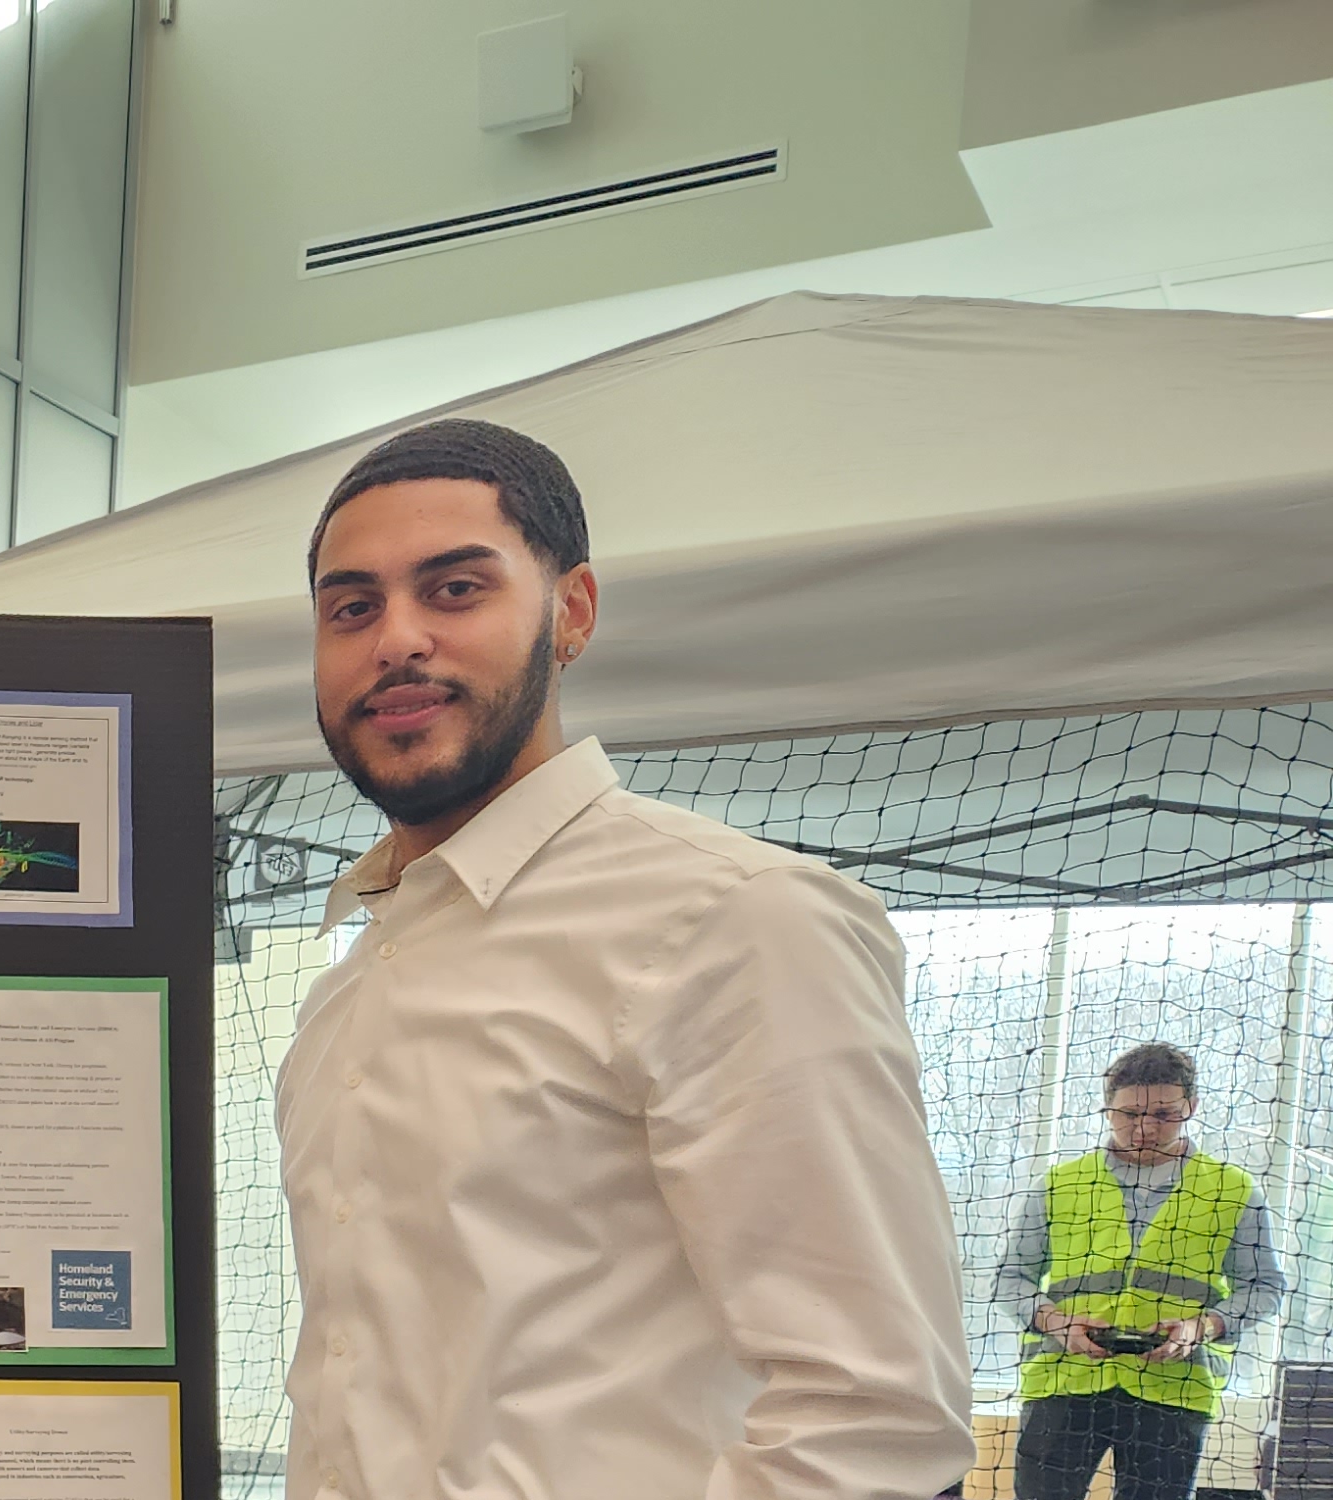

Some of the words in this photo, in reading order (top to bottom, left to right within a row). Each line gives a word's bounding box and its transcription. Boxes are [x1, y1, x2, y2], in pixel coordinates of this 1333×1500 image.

[59, 1263, 113, 1274] Homeland
[59, 1276, 103, 1290] Security
[105, 1277, 115, 1287] &
[59, 1288, 119, 1303] Emergency
[59, 1301, 104, 1312] Services
